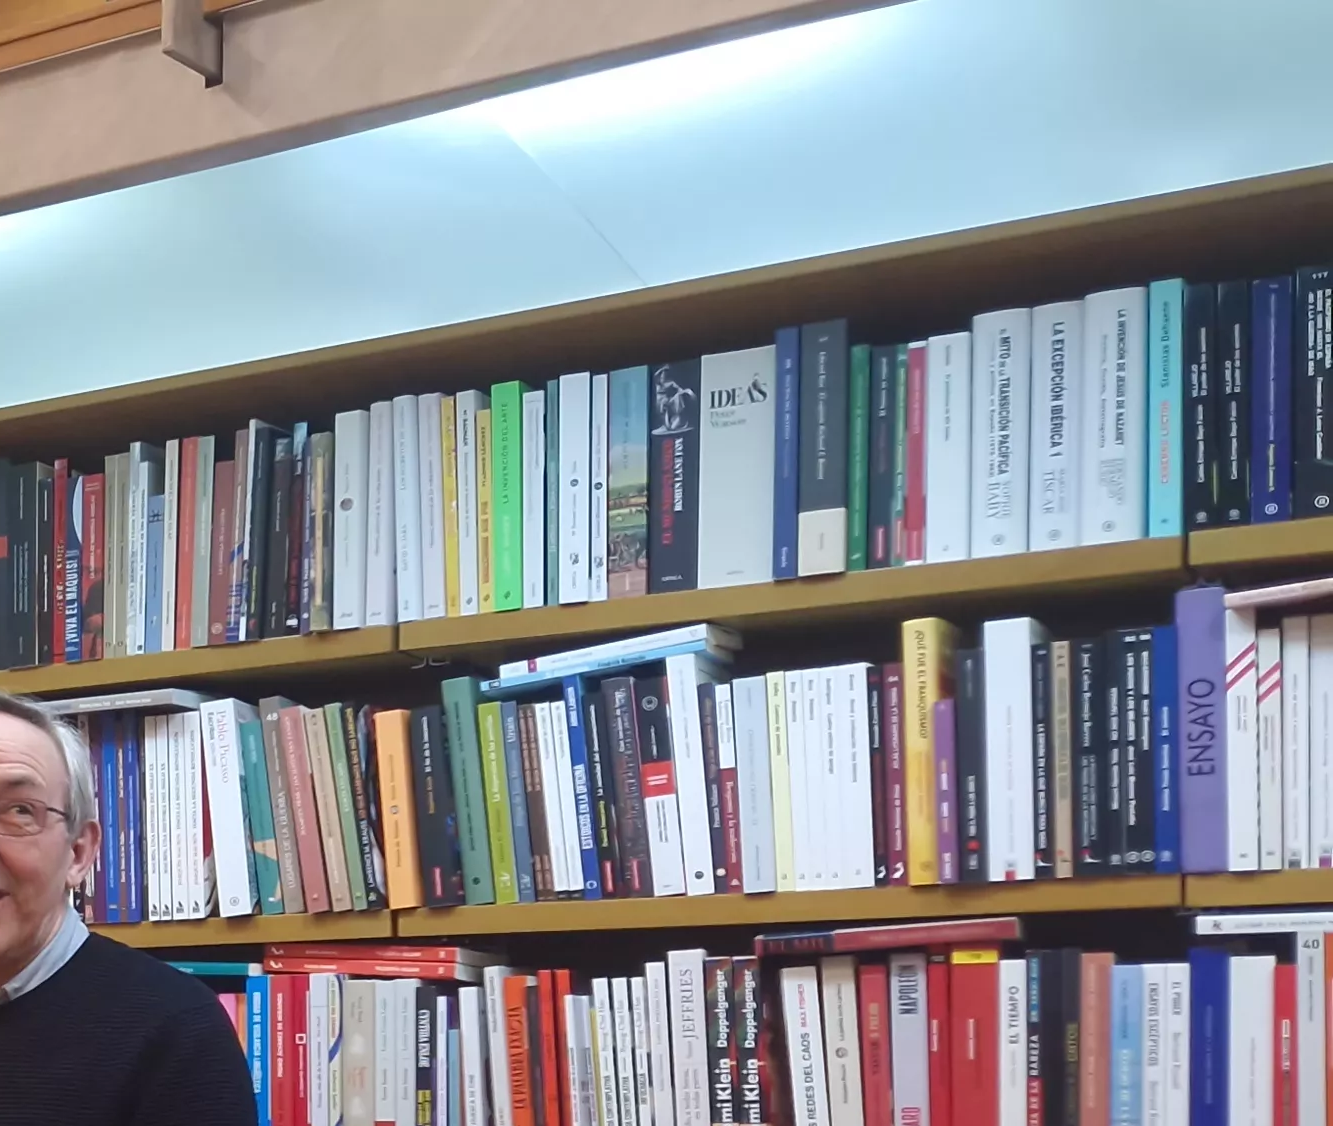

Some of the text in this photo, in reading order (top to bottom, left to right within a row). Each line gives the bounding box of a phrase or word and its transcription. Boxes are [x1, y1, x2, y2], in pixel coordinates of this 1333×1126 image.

[1052, 321, 1065, 337] LA
[1117, 308, 1126, 319] LA
[1116, 320, 1128, 361] INVENCIÓN
[1051, 338, 1067, 402] EXCEPCIÓN
[1116, 362, 1125, 373] DE
[709, 372, 769, 410] IDEAS
[997, 336, 1012, 475] MITO TRANSICIÓN PACÍFICA
[1116, 399, 1125, 409] DE
[1049, 404, 1066, 449] IBÉRICA
[1114, 411, 1125, 447] NAZARET
[674, 456, 683, 481] LANE
[65, 559, 79, 643] ¡VIVA EL MAQUIS!
[917, 652, 926, 667] FUE
[917, 669, 926, 679] EL
[1187, 678, 1215, 776] ENSAYO
[216, 710, 231, 783] Pablo Picasso
[281, 826, 290, 838] LA
[283, 839, 291, 851] DE
[1302, 939, 1320, 950] 40
[679, 967, 698, 1040] JEFFRIES
[714, 969, 730, 1048] Doppelganger
[742, 969, 757, 1048] Doppelganger
[797, 984, 807, 1010] FISHER
[799, 1011, 808, 1028] MAX
[1008, 986, 1019, 1044] EL TIEMPO
[800, 1032, 813, 1061] CAOS
[713, 1058, 732, 1100] Klein
[741, 1058, 761, 1101] Klein
[804, 1063, 815, 1084] DEL
[806, 1085, 818, 1120] REDES
